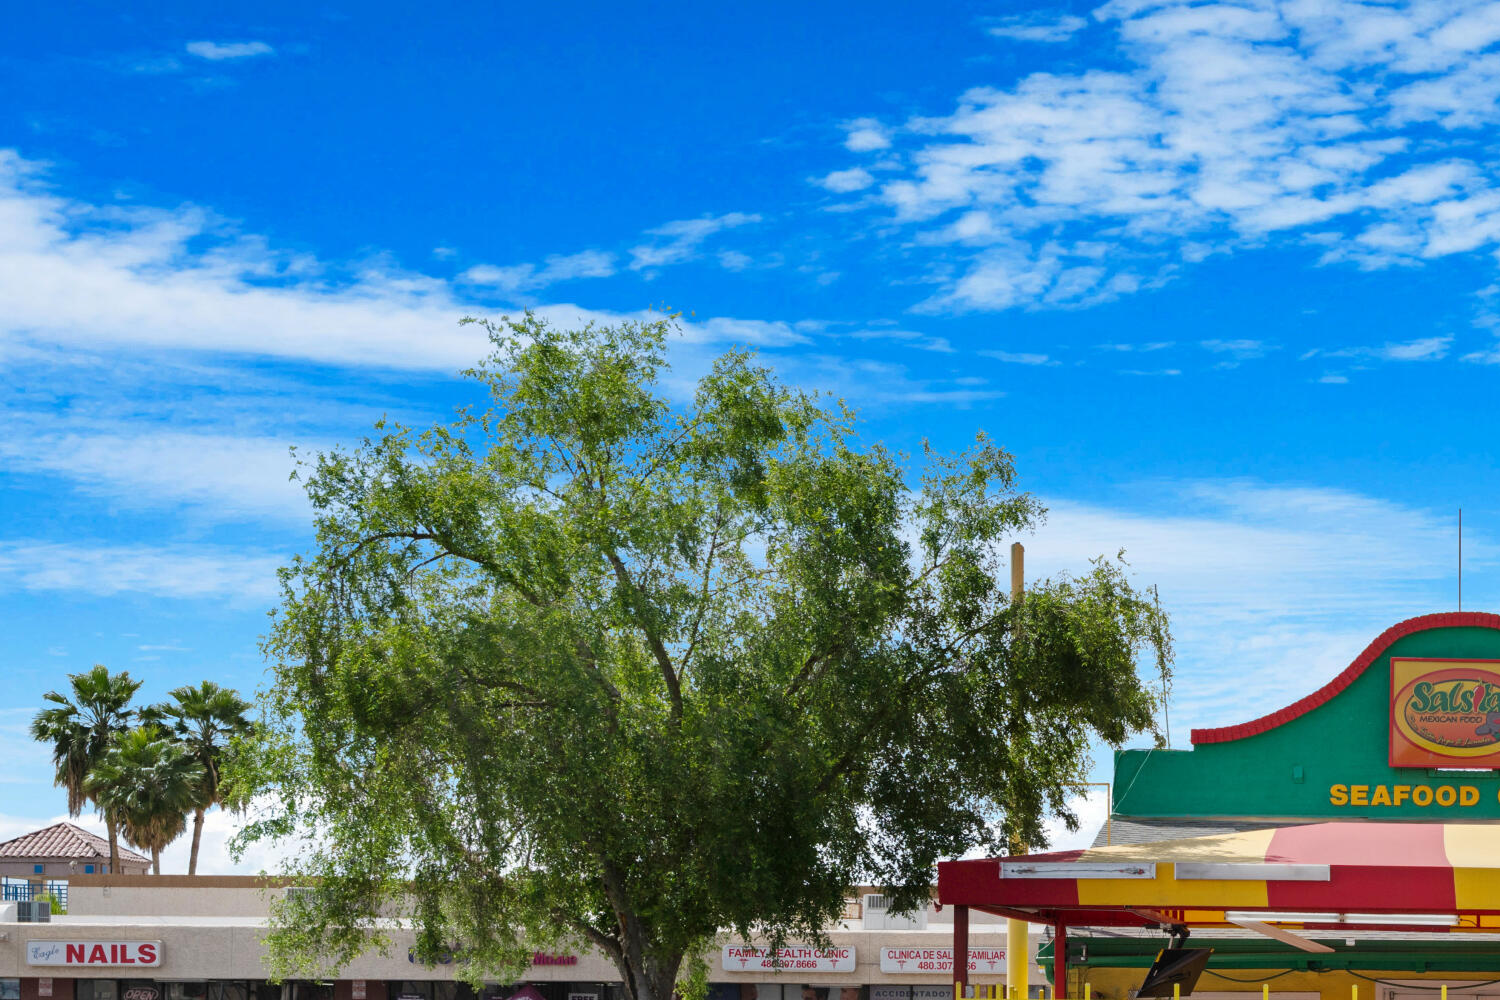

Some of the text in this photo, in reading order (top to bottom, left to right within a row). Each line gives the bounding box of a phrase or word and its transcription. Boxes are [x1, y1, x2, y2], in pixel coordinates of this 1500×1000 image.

[1419, 715, 1482, 724] MEXICAN FOOD
[1329, 784, 1480, 806] SEAFOOD
[66, 944, 157, 964] NAILS
[728, 948, 767, 958] FAMILY
[887, 950, 922, 960] CLINICA
[922, 950, 935, 960] DE
[967, 950, 1006, 960] FAMILIAR
[917, 961, 977, 970] 480.307.6
[125, 989, 154, 1000] OPEN
